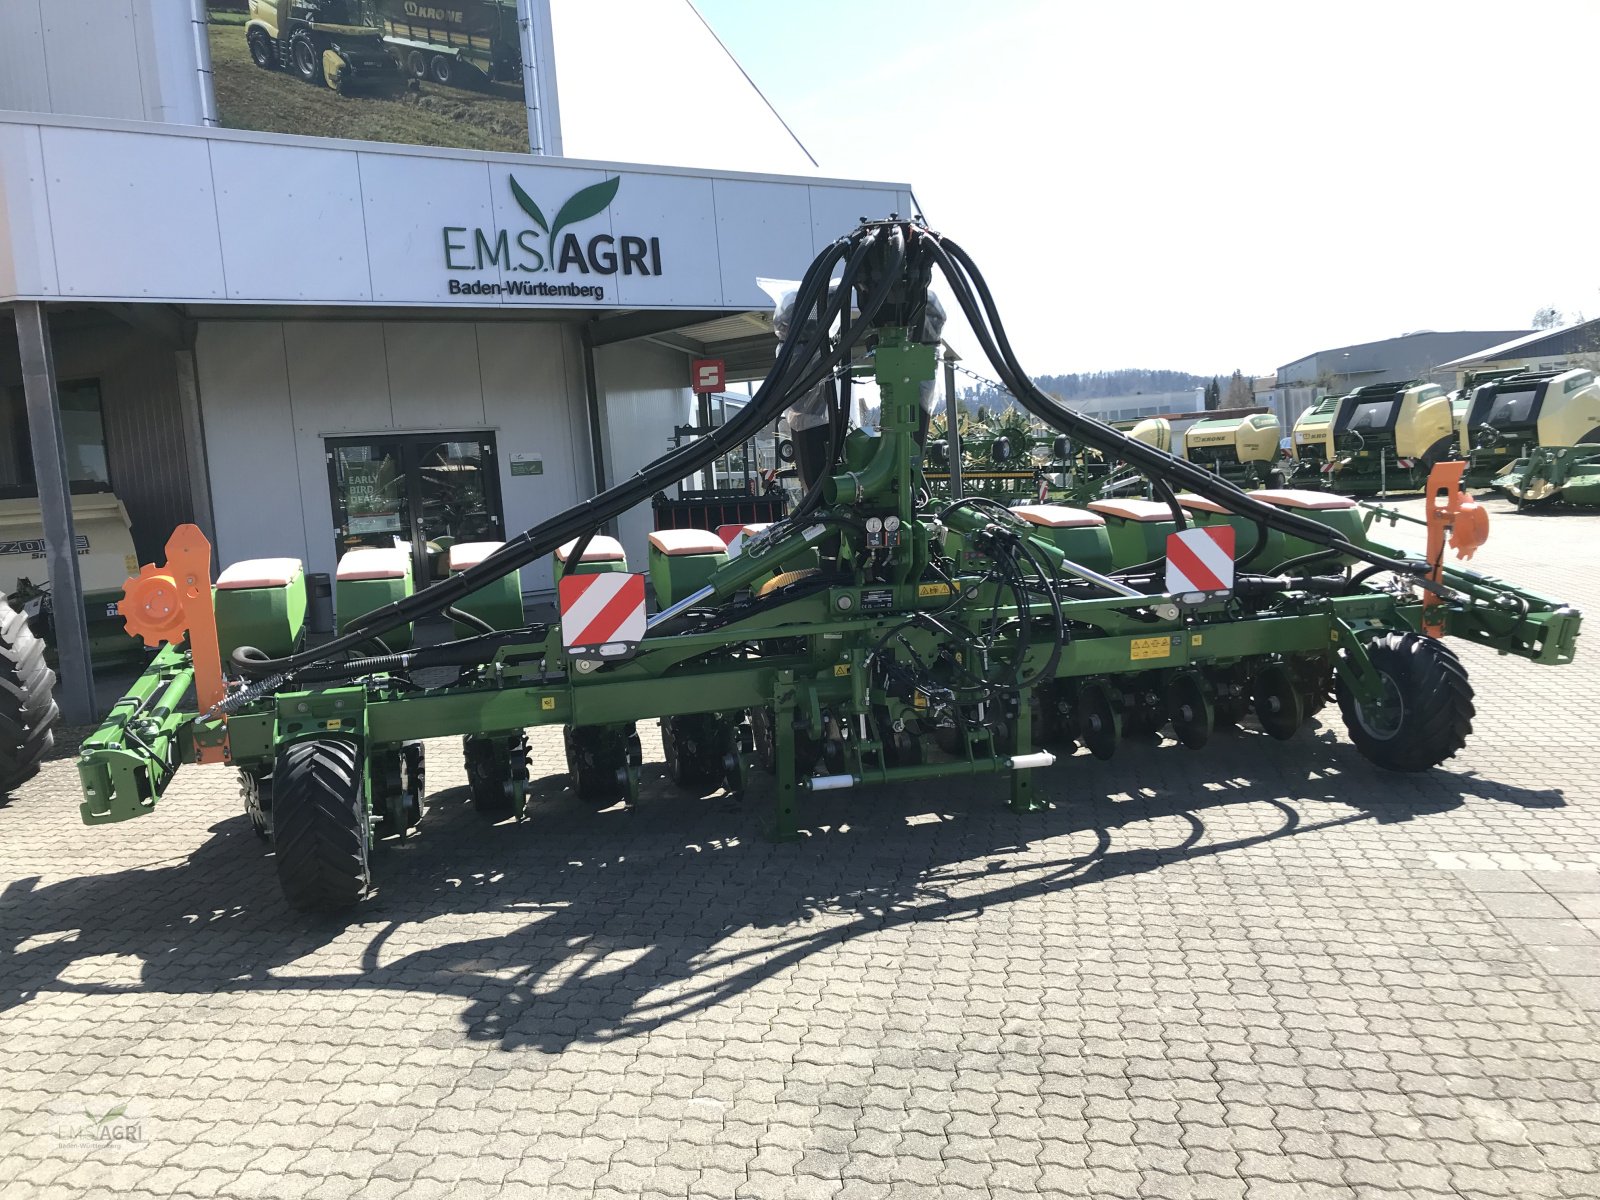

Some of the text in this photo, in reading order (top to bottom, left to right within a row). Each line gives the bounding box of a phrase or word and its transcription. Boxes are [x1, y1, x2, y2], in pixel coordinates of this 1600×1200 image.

[418, 6, 463, 23] KRONE
[559, 233, 662, 276] AGRI
[449, 279, 604, 300] Baden-Württemberg
[348, 474, 379, 485] EARLY
[350, 485, 374, 495] BIRD
